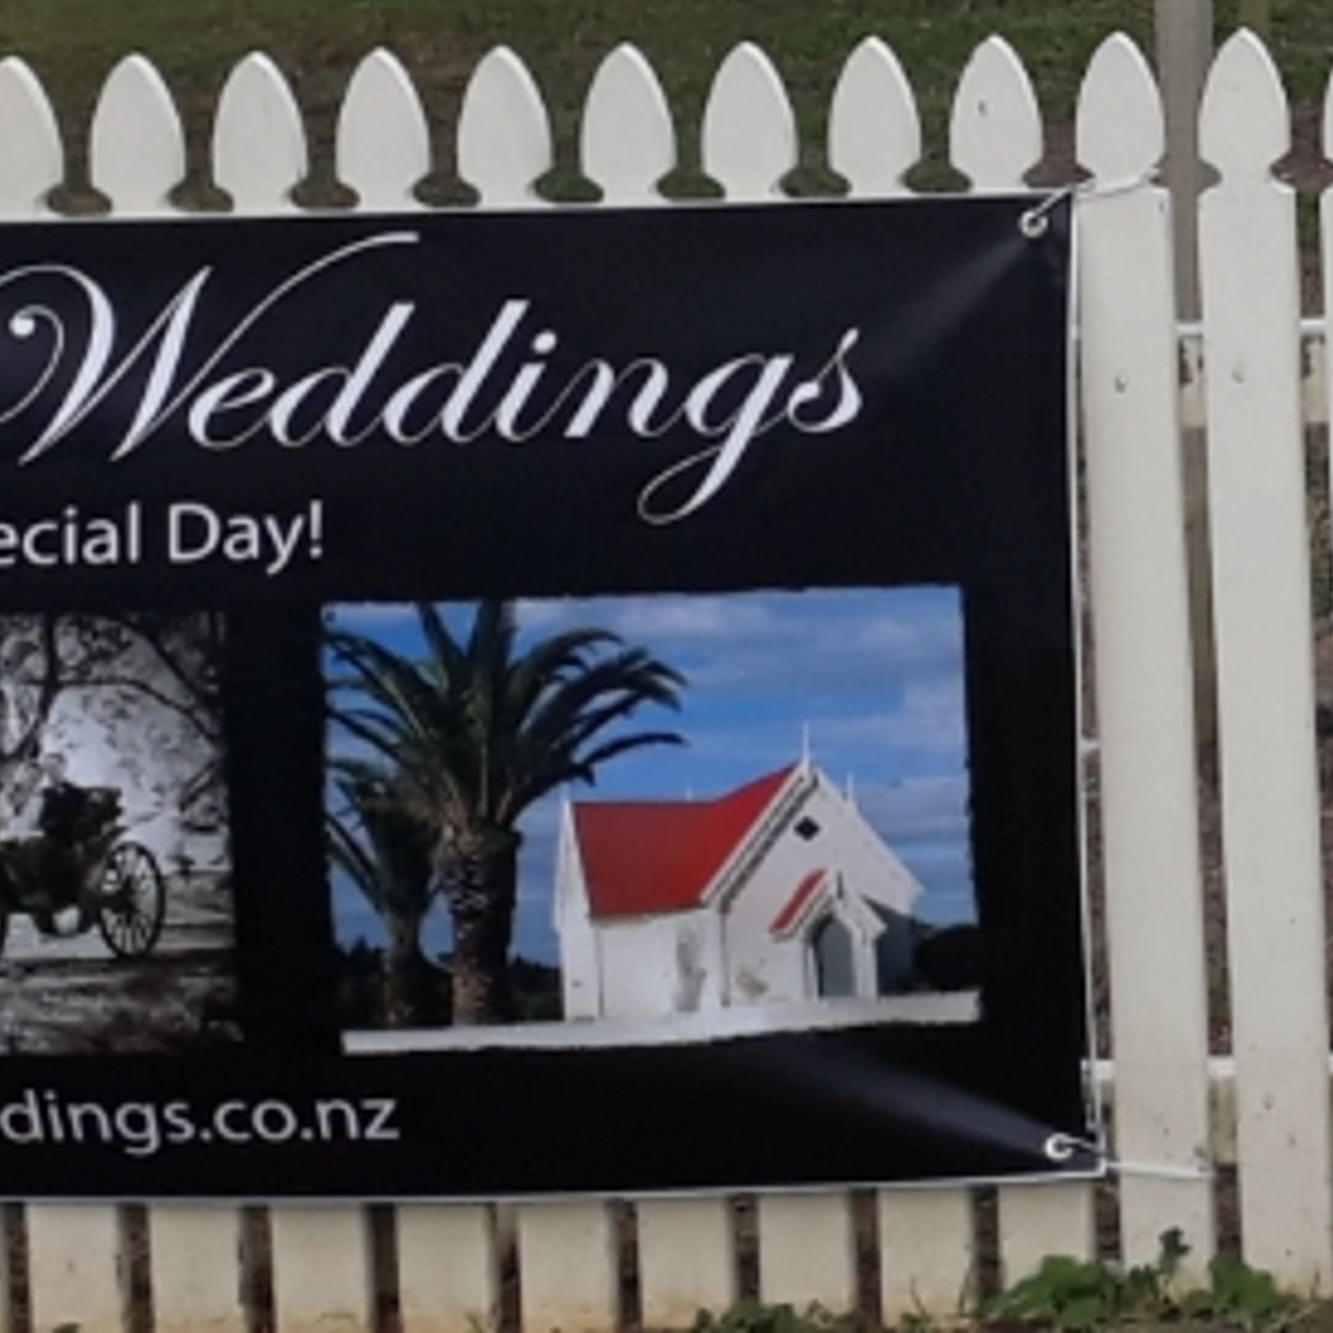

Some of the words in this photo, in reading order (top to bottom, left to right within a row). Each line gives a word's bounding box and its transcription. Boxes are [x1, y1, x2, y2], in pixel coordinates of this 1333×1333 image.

[0, 232, 864, 525] Weddings
[168, 499, 323, 576] Day!
[0, 1088, 400, 1157] dings.co.nz
